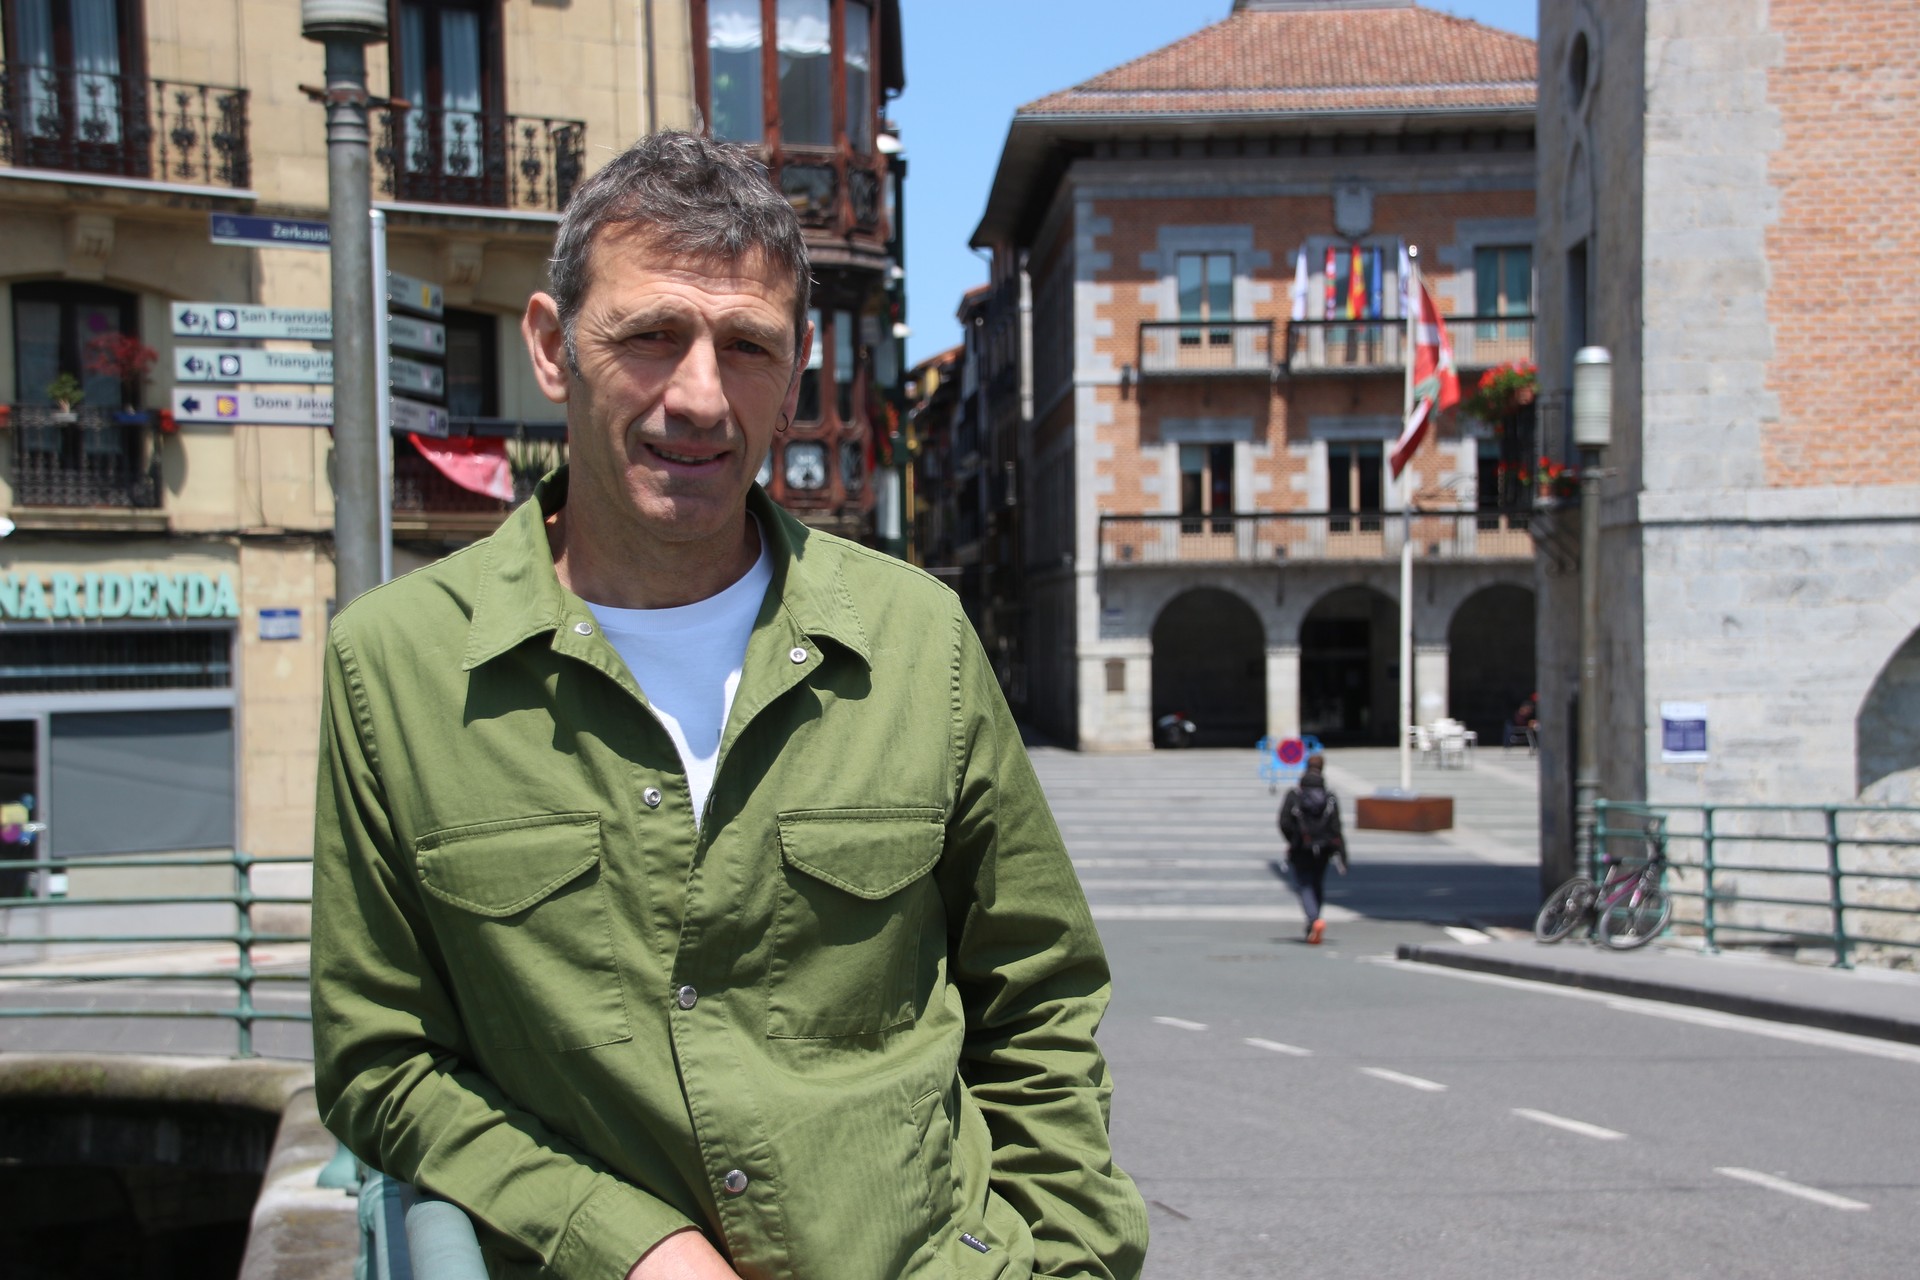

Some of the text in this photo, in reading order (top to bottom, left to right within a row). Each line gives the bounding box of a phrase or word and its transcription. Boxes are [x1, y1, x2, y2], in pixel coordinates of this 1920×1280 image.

[271, 222, 331, 241] Zerkausi
[241, 310, 332, 325] San Frantzisk
[254, 396, 292, 409] Done
[0, 572, 240, 618] NARIDENDA
